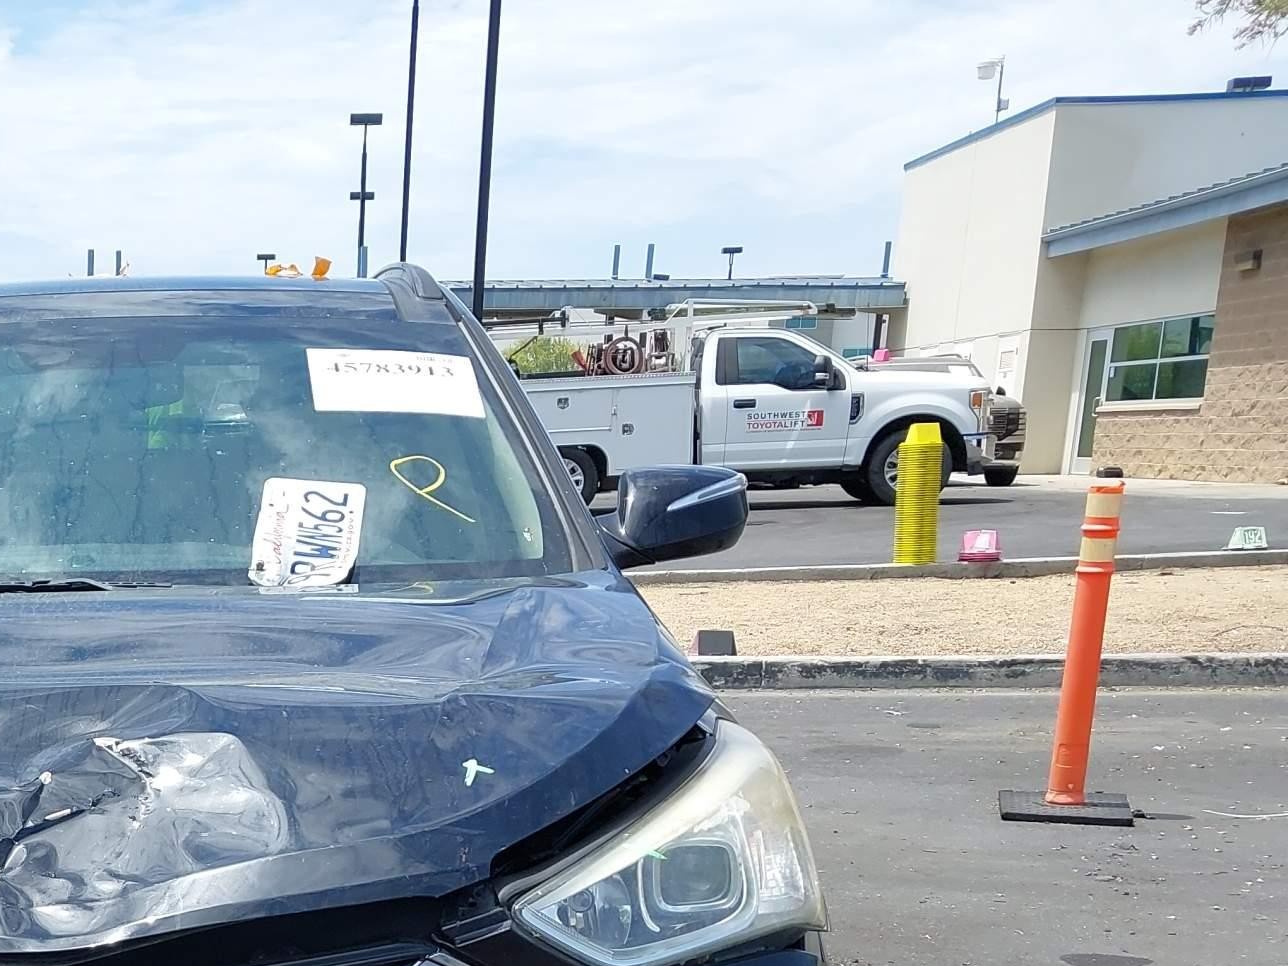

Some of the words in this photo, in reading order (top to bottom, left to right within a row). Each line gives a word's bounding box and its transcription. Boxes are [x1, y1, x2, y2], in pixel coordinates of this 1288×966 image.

[327, 361, 455, 377] 45783913
[746, 411, 807, 420] SOUTHWEST
[746, 420, 806, 429] TOYOTALIFT
[1244, 530, 1262, 544] 192
